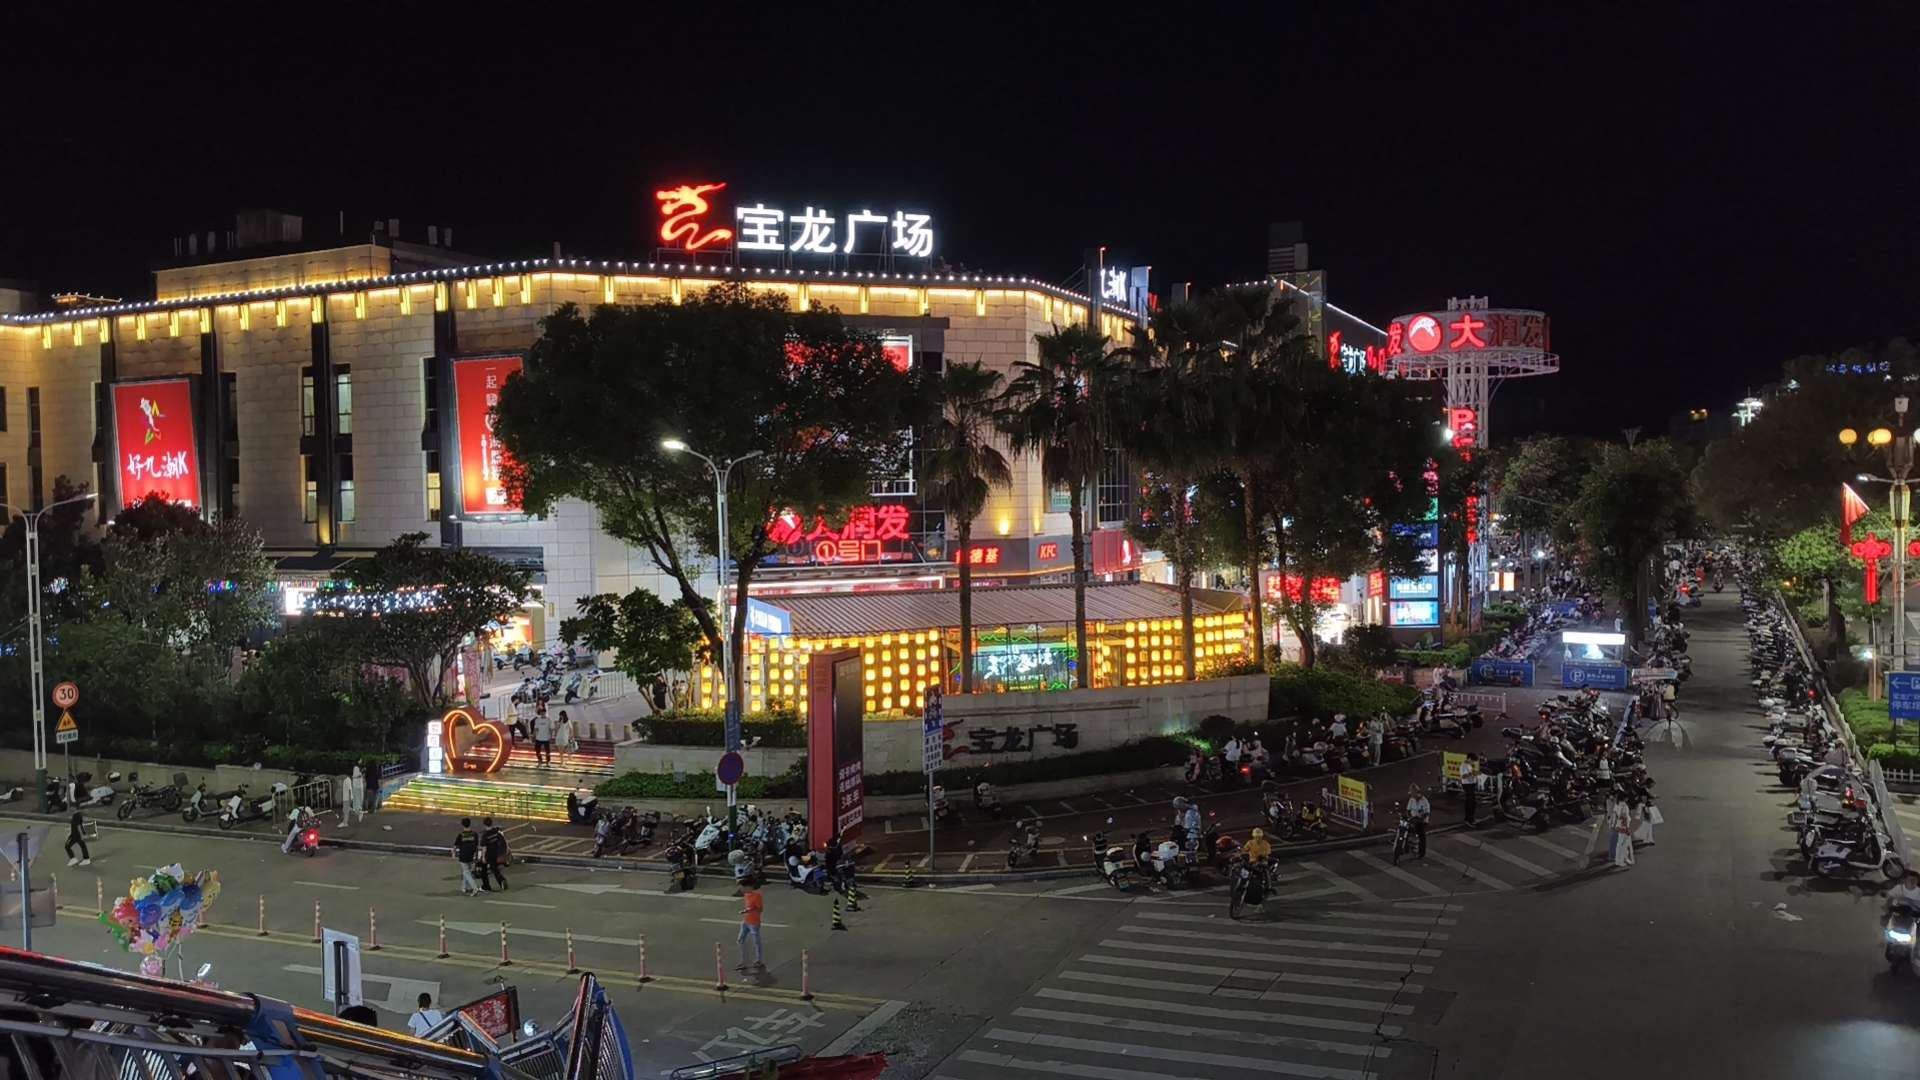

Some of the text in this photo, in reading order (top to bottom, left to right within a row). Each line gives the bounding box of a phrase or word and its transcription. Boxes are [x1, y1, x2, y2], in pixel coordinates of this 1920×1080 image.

[736, 204, 934, 257] 宝龙广场
[1039, 544, 1057, 560] KFC
[60, 687, 74, 700] 30
[968, 723, 1079, 755] 宝龙广场
